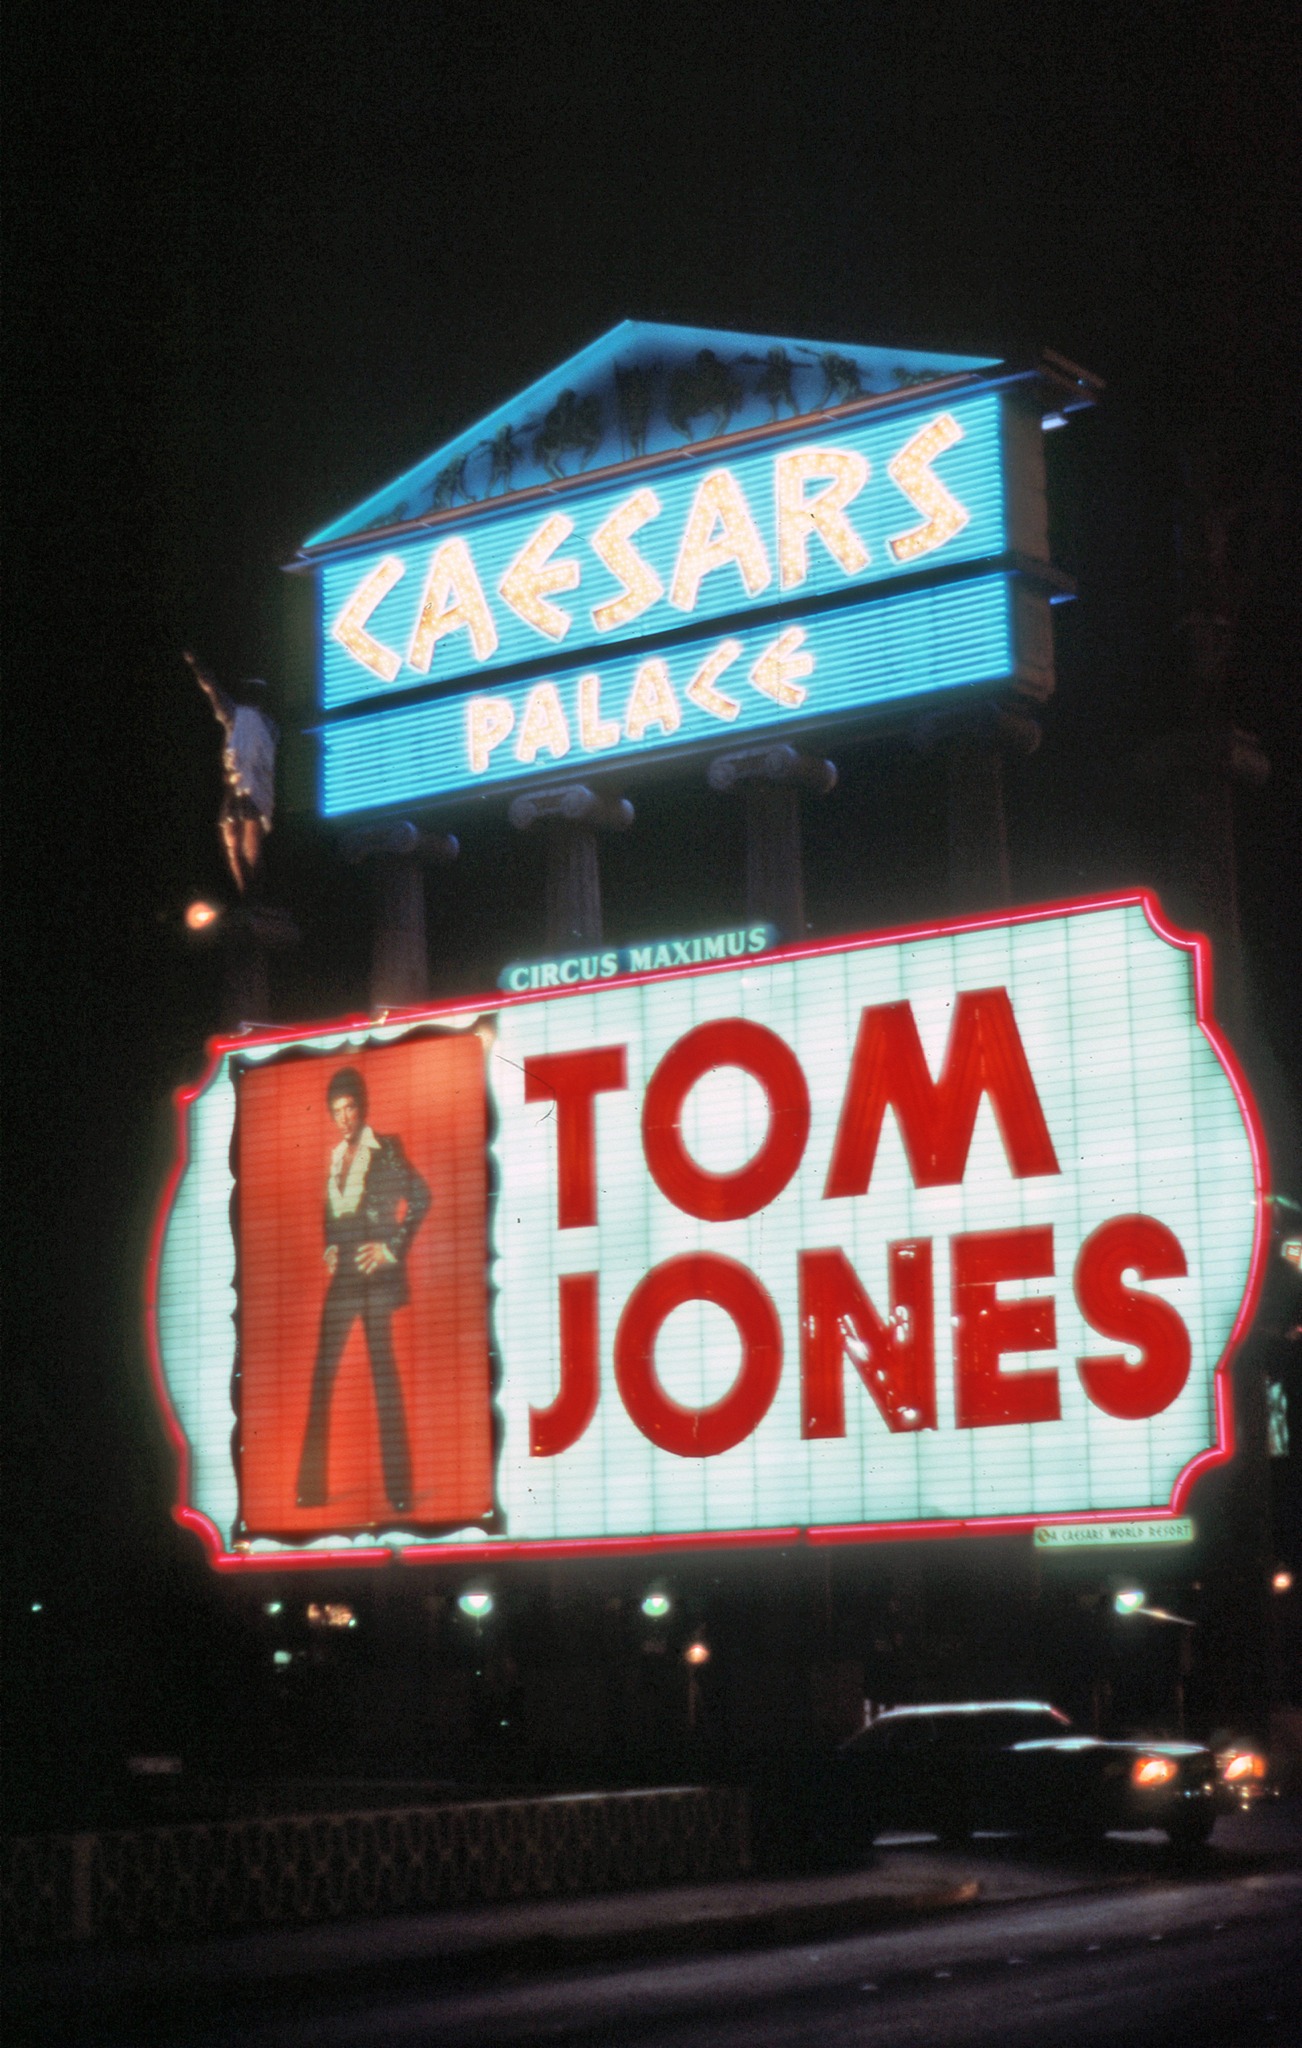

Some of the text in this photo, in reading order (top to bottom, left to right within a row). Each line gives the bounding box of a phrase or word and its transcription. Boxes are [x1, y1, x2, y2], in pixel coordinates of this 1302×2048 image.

[331, 413, 971, 683] CAESARS
[465, 625, 815, 774] PALACE
[508, 927, 766, 991] CIRCUS MAXIMUS
[523, 985, 1062, 1230] TOM
[528, 1213, 1192, 1459] JONES
[1108, 1525, 1144, 1539] WORLD
[1150, 1525, 1190, 1537] RESORT
